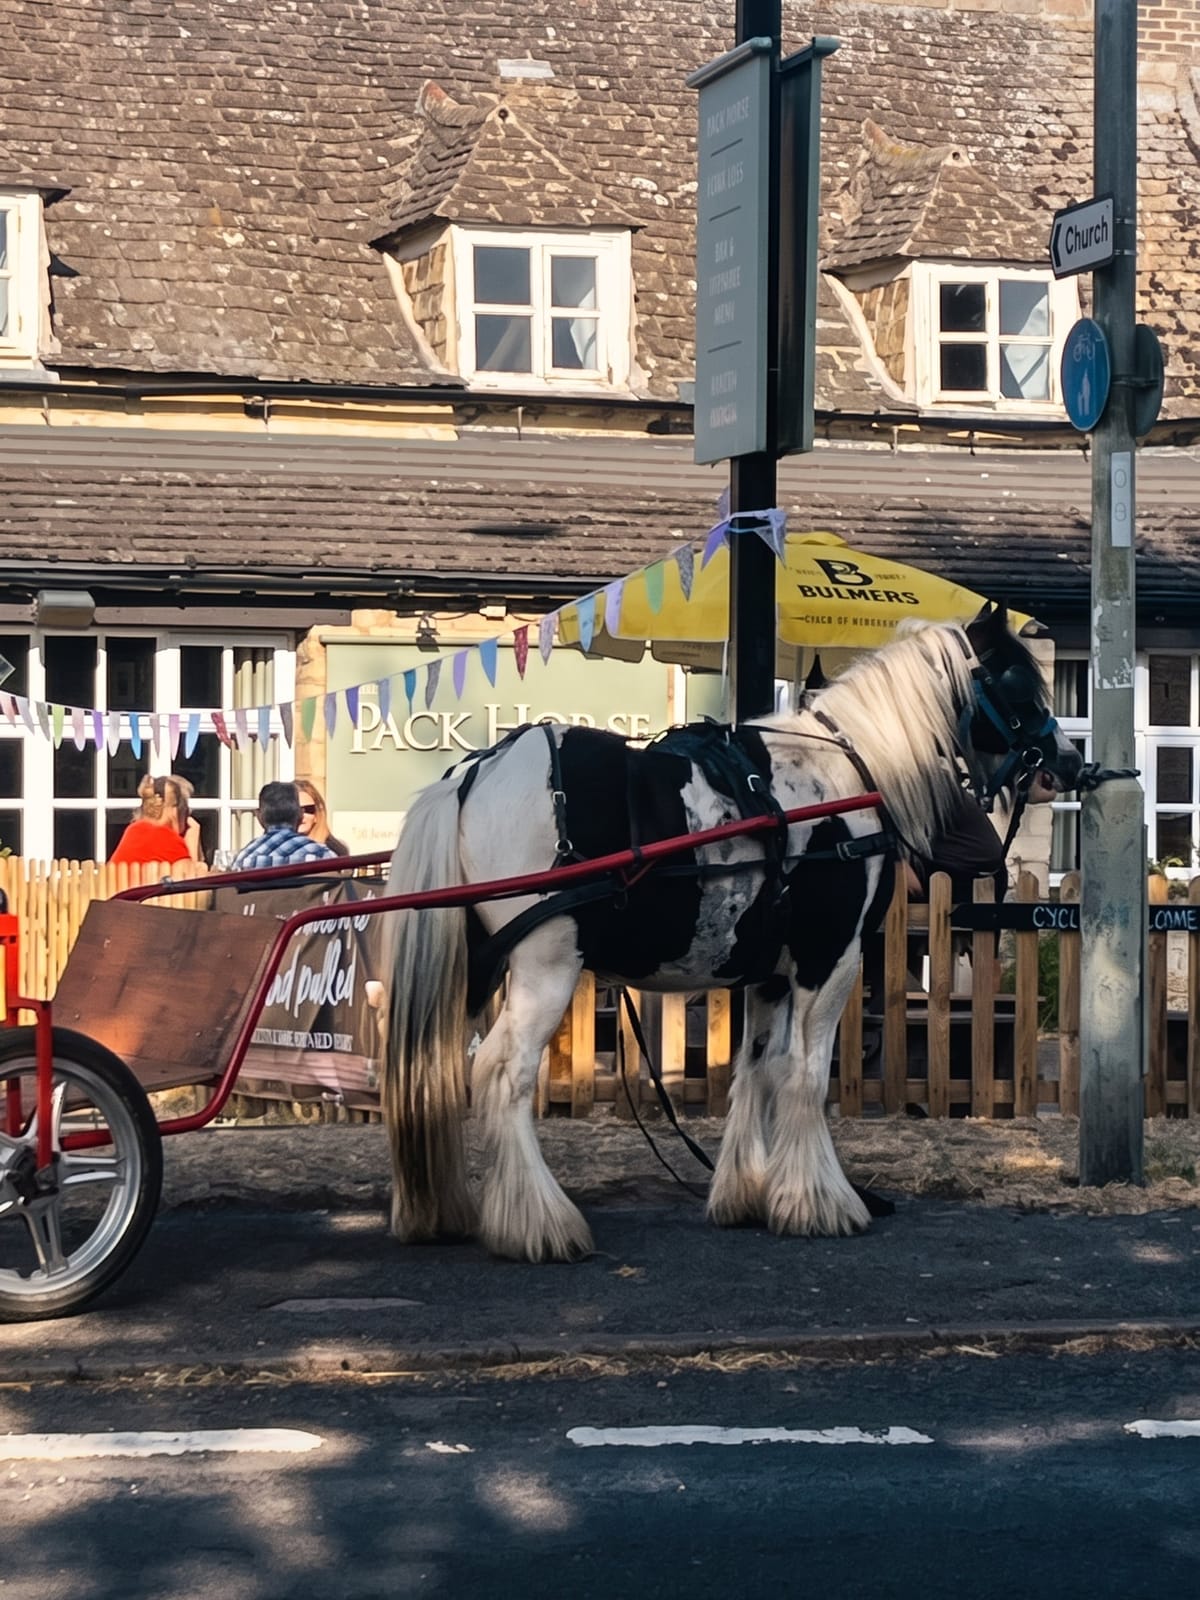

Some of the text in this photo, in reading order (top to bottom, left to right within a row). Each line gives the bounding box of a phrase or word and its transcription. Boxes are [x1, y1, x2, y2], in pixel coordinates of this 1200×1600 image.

[1065, 214, 1108, 255] Church
[797, 584, 920, 605] BULMERS
[349, 701, 652, 754] PACK HSE
[1032, 905, 1198, 930] CYCL COME
[294, 938, 357, 1018] pulled
